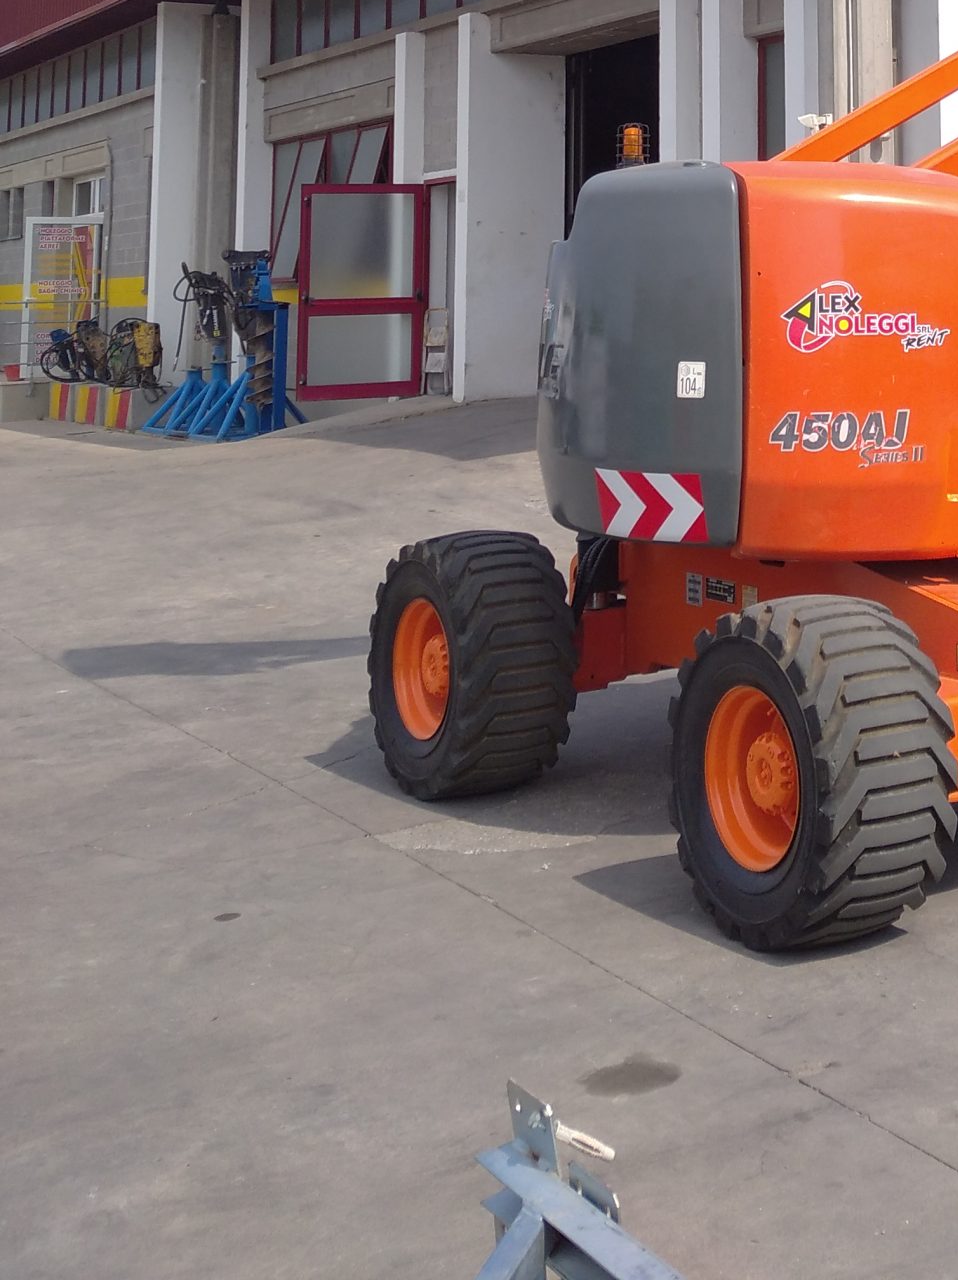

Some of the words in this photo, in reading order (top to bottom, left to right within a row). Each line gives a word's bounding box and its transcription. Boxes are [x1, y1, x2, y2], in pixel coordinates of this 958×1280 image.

[780, 288, 862, 335] ALEX
[818, 314, 917, 336] NOLEGGI
[917, 325, 931, 334] SRL
[901, 329, 949, 351] RENT
[680, 377, 697, 395] 104
[769, 409, 910, 452] 450AJ
